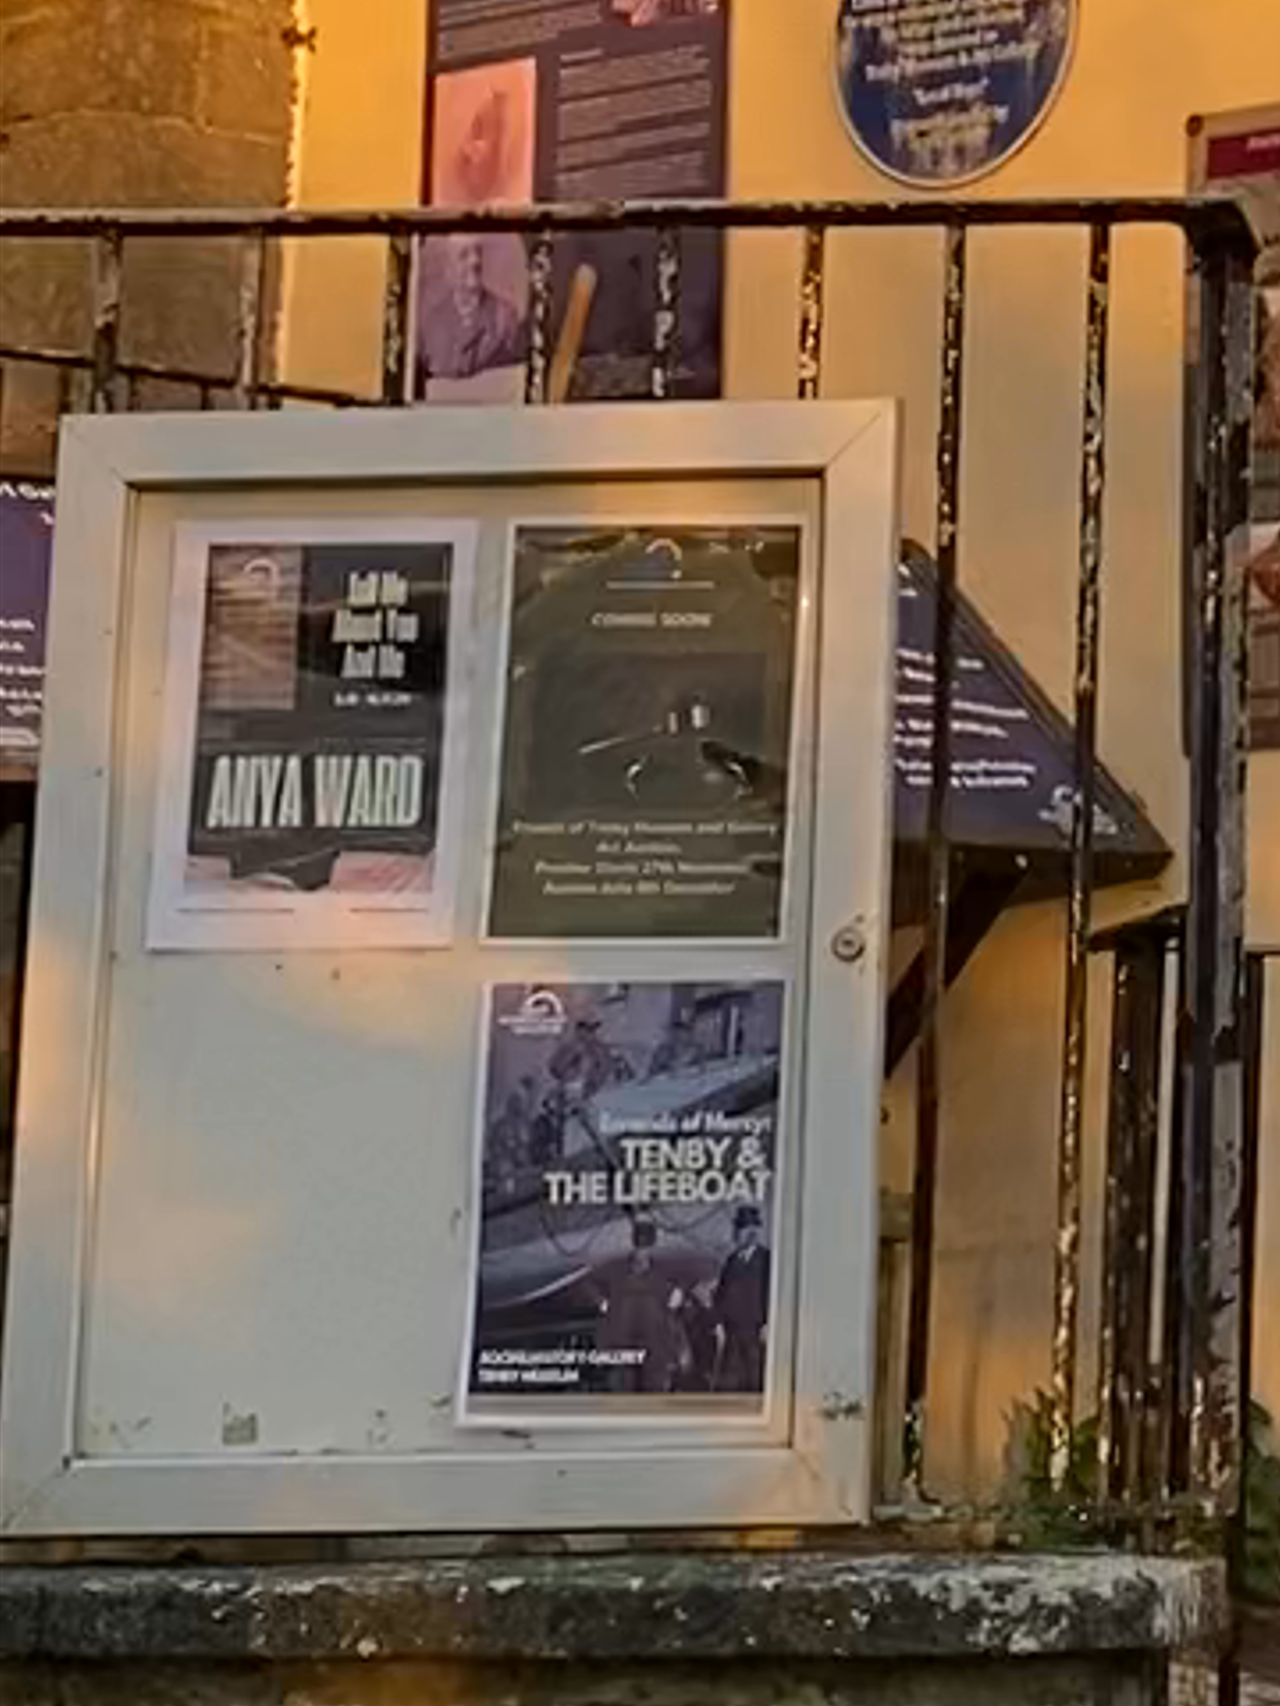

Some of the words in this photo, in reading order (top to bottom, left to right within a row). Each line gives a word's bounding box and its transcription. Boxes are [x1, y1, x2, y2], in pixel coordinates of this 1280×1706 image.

[207, 754, 301, 829] ANYA
[314, 754, 422, 829] WARD
[619, 1137, 731, 1171] TENBY
[736, 1137, 767, 1170] &
[543, 1169, 609, 1205] THE
[613, 1169, 773, 1203] LIFEBOAT
